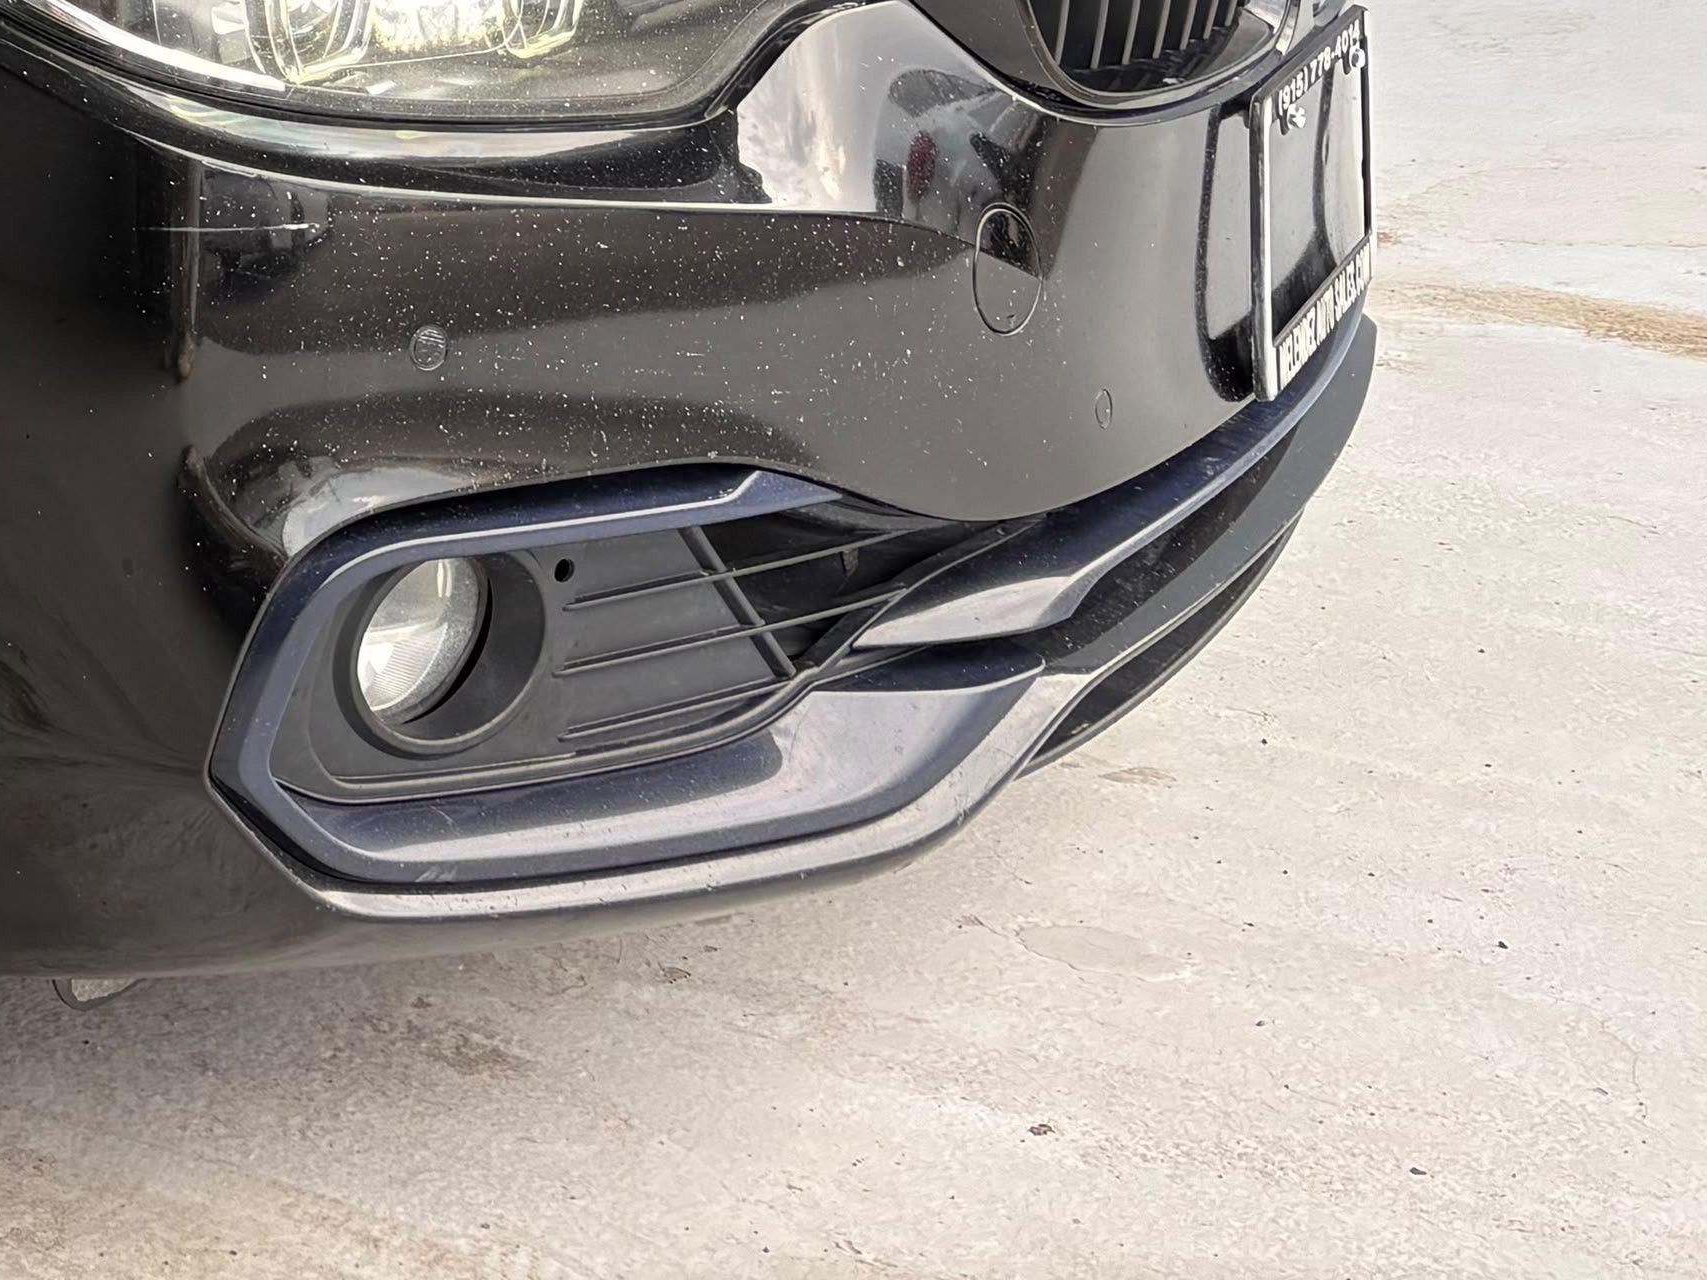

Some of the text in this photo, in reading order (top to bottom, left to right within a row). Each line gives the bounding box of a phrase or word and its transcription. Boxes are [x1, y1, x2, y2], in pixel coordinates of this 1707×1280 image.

[1278, 18, 1360, 116] (915) 778-4014
[1279, 305, 1317, 391] MELENDEZ
[1317, 284, 1335, 347] AUTO
